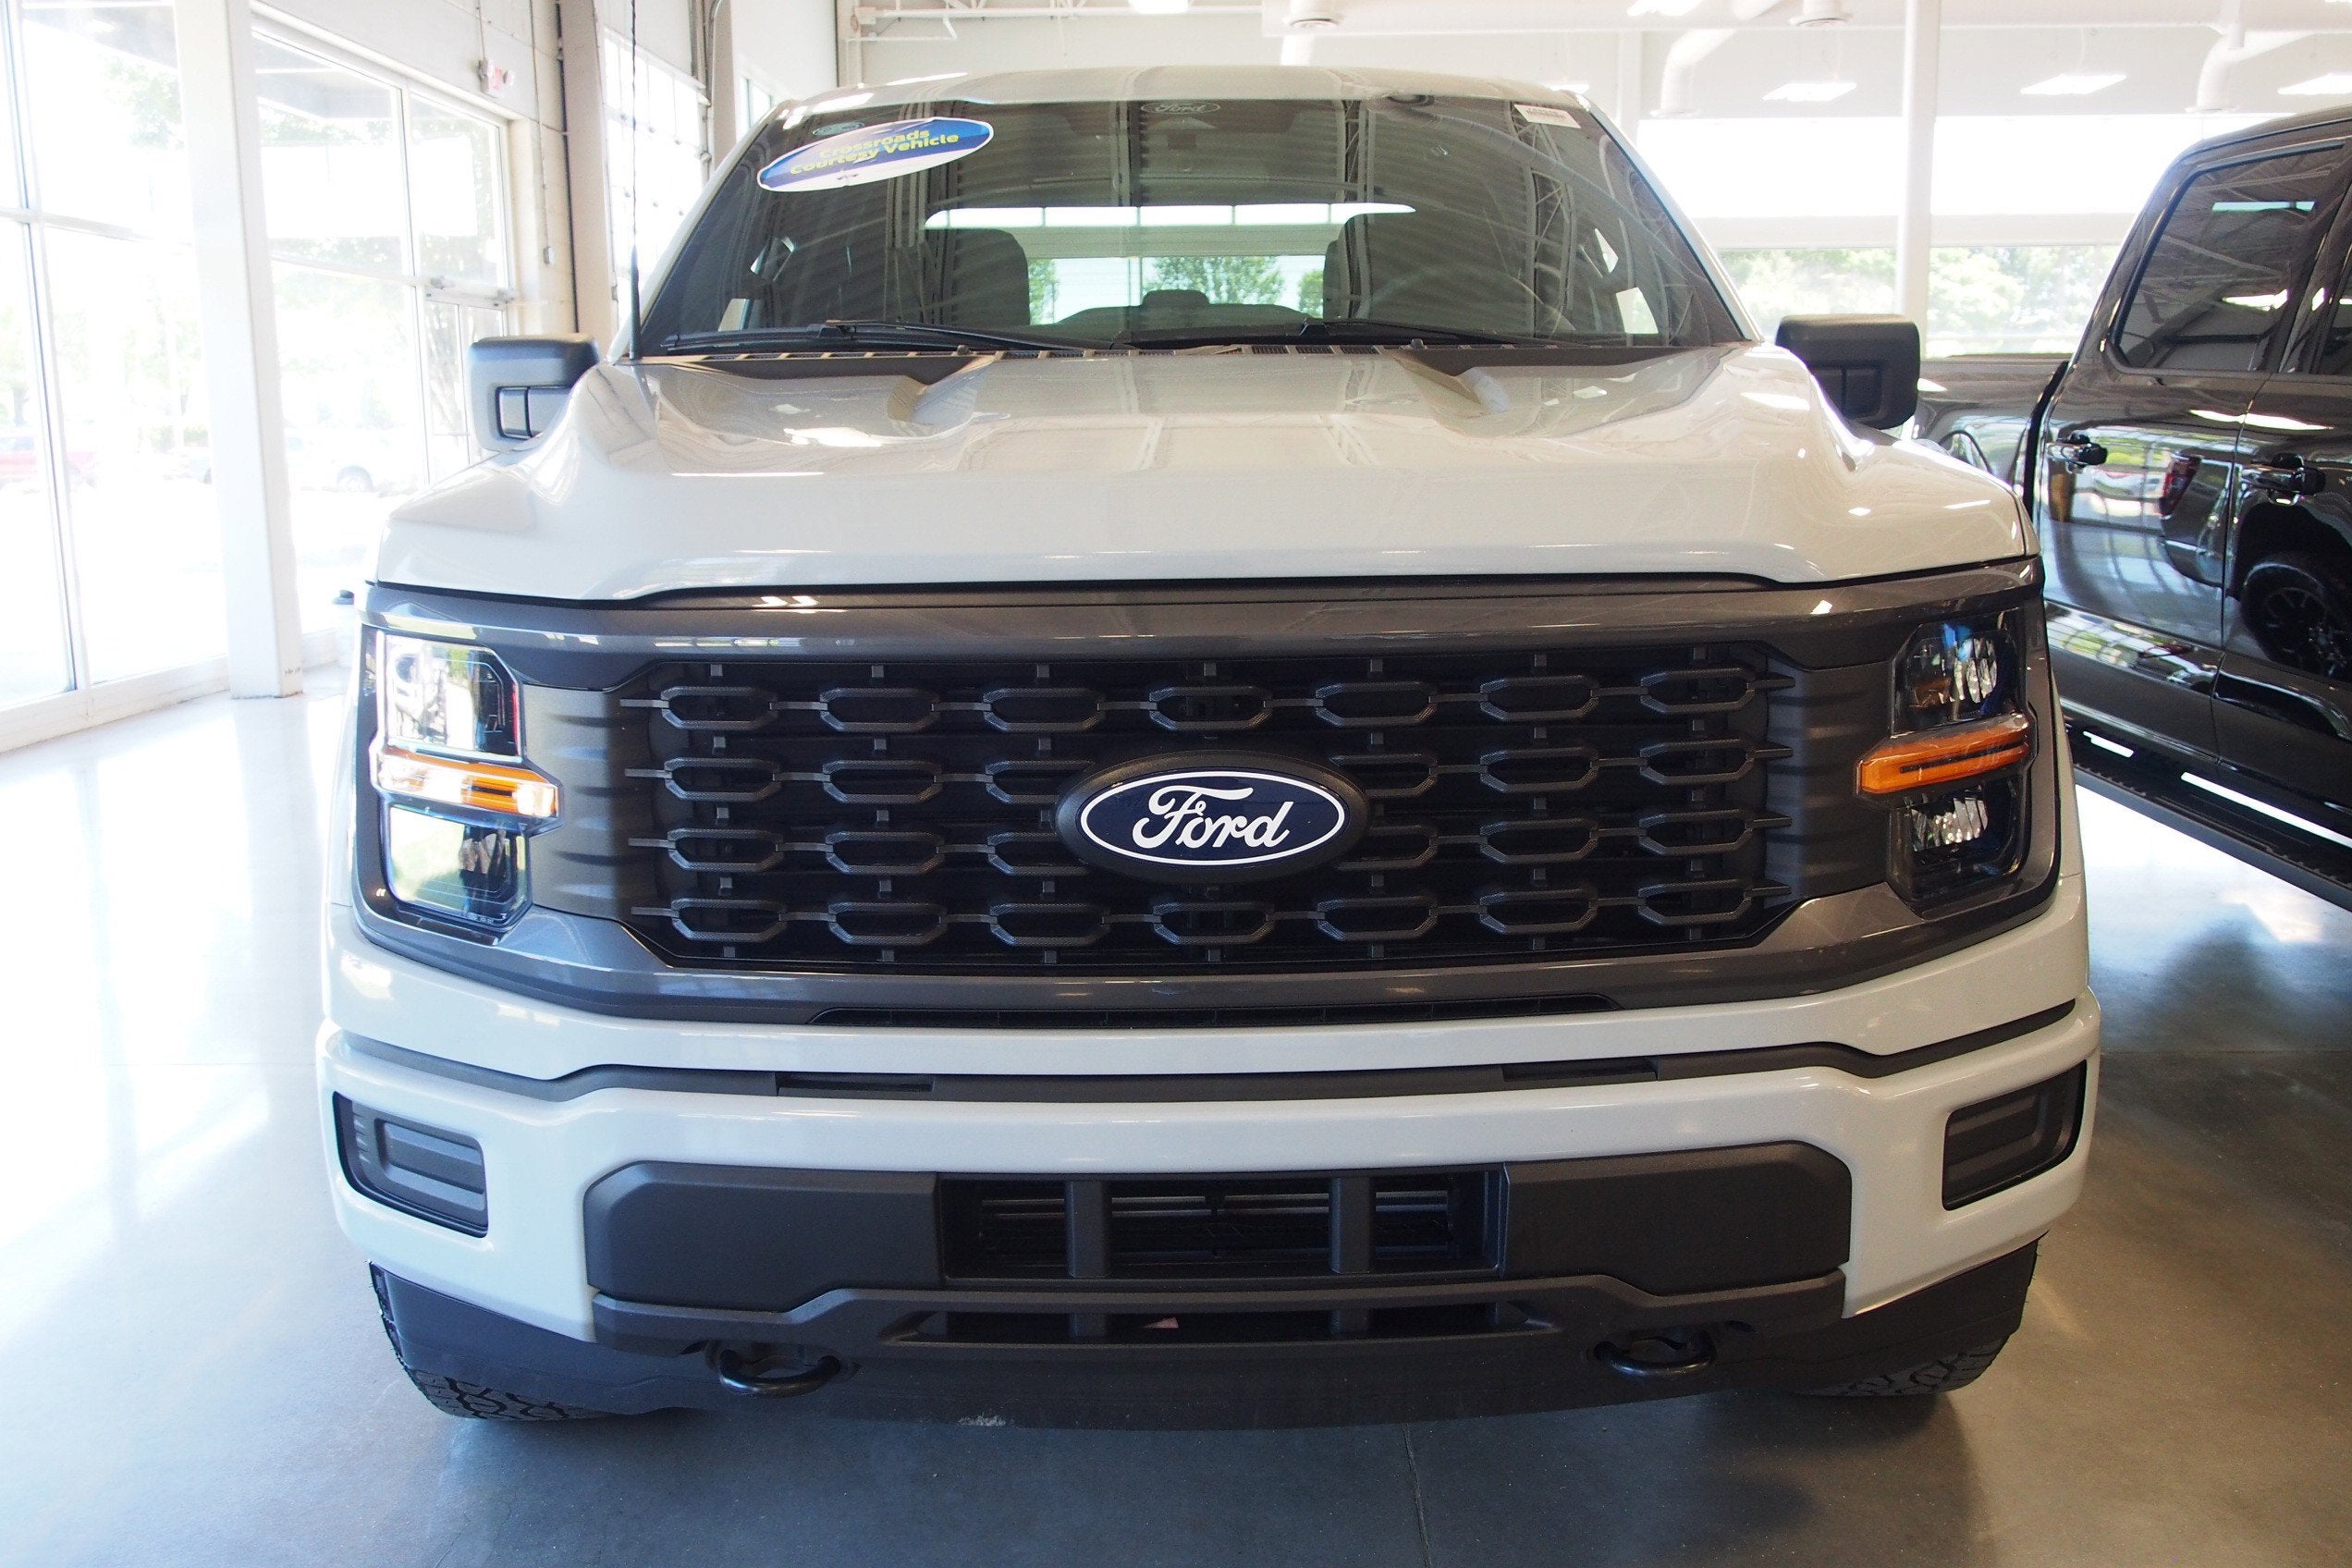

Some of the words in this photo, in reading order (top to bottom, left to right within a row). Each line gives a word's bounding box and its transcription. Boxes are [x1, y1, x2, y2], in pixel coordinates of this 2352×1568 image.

[790, 149, 878, 175] Courtesy
[882, 134, 960, 153] Vehicle
[820, 129, 930, 158] Crossroads
[1132, 785, 1294, 849] Ford
